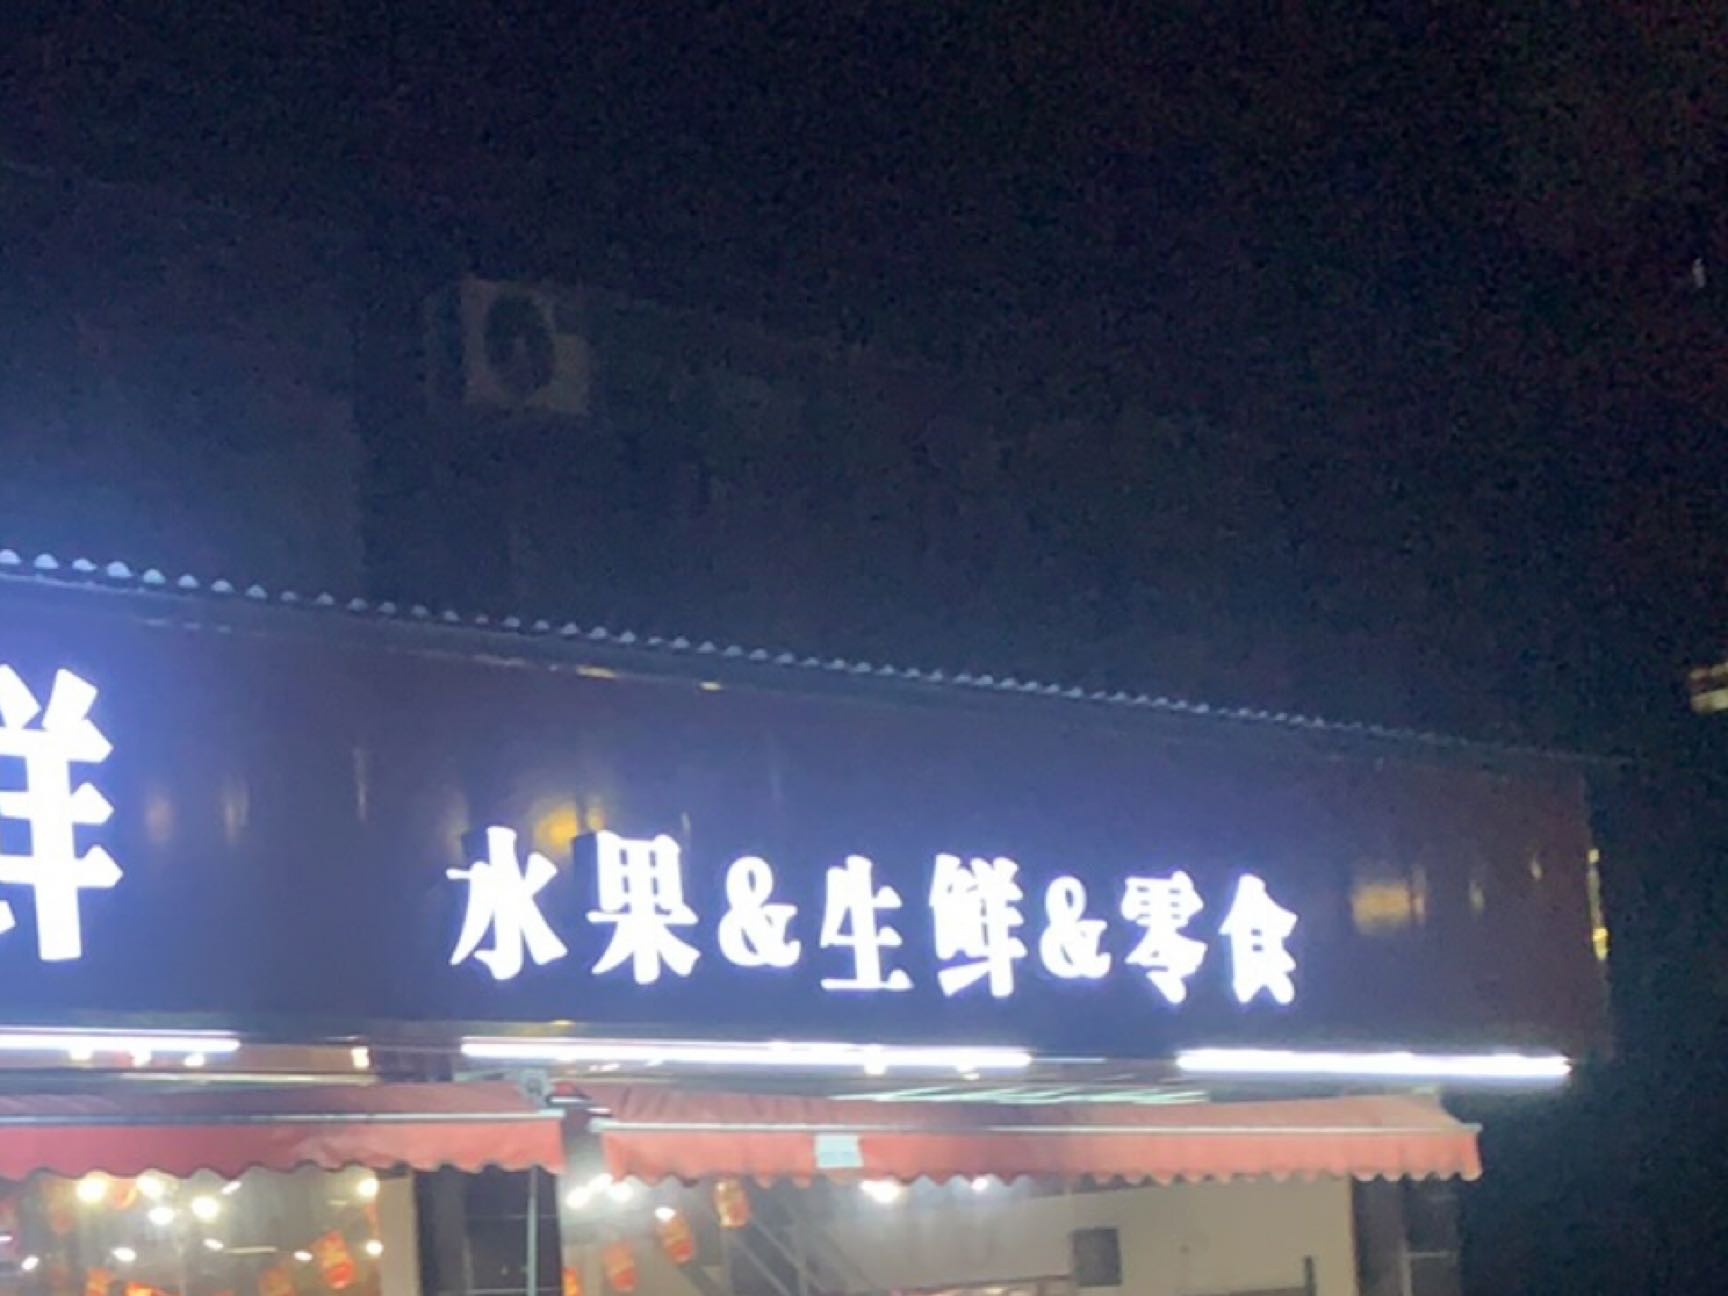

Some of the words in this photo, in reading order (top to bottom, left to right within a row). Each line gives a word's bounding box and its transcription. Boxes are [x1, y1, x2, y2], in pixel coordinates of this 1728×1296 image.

[445, 822, 1300, 1006] 水果&生鲜&零食
